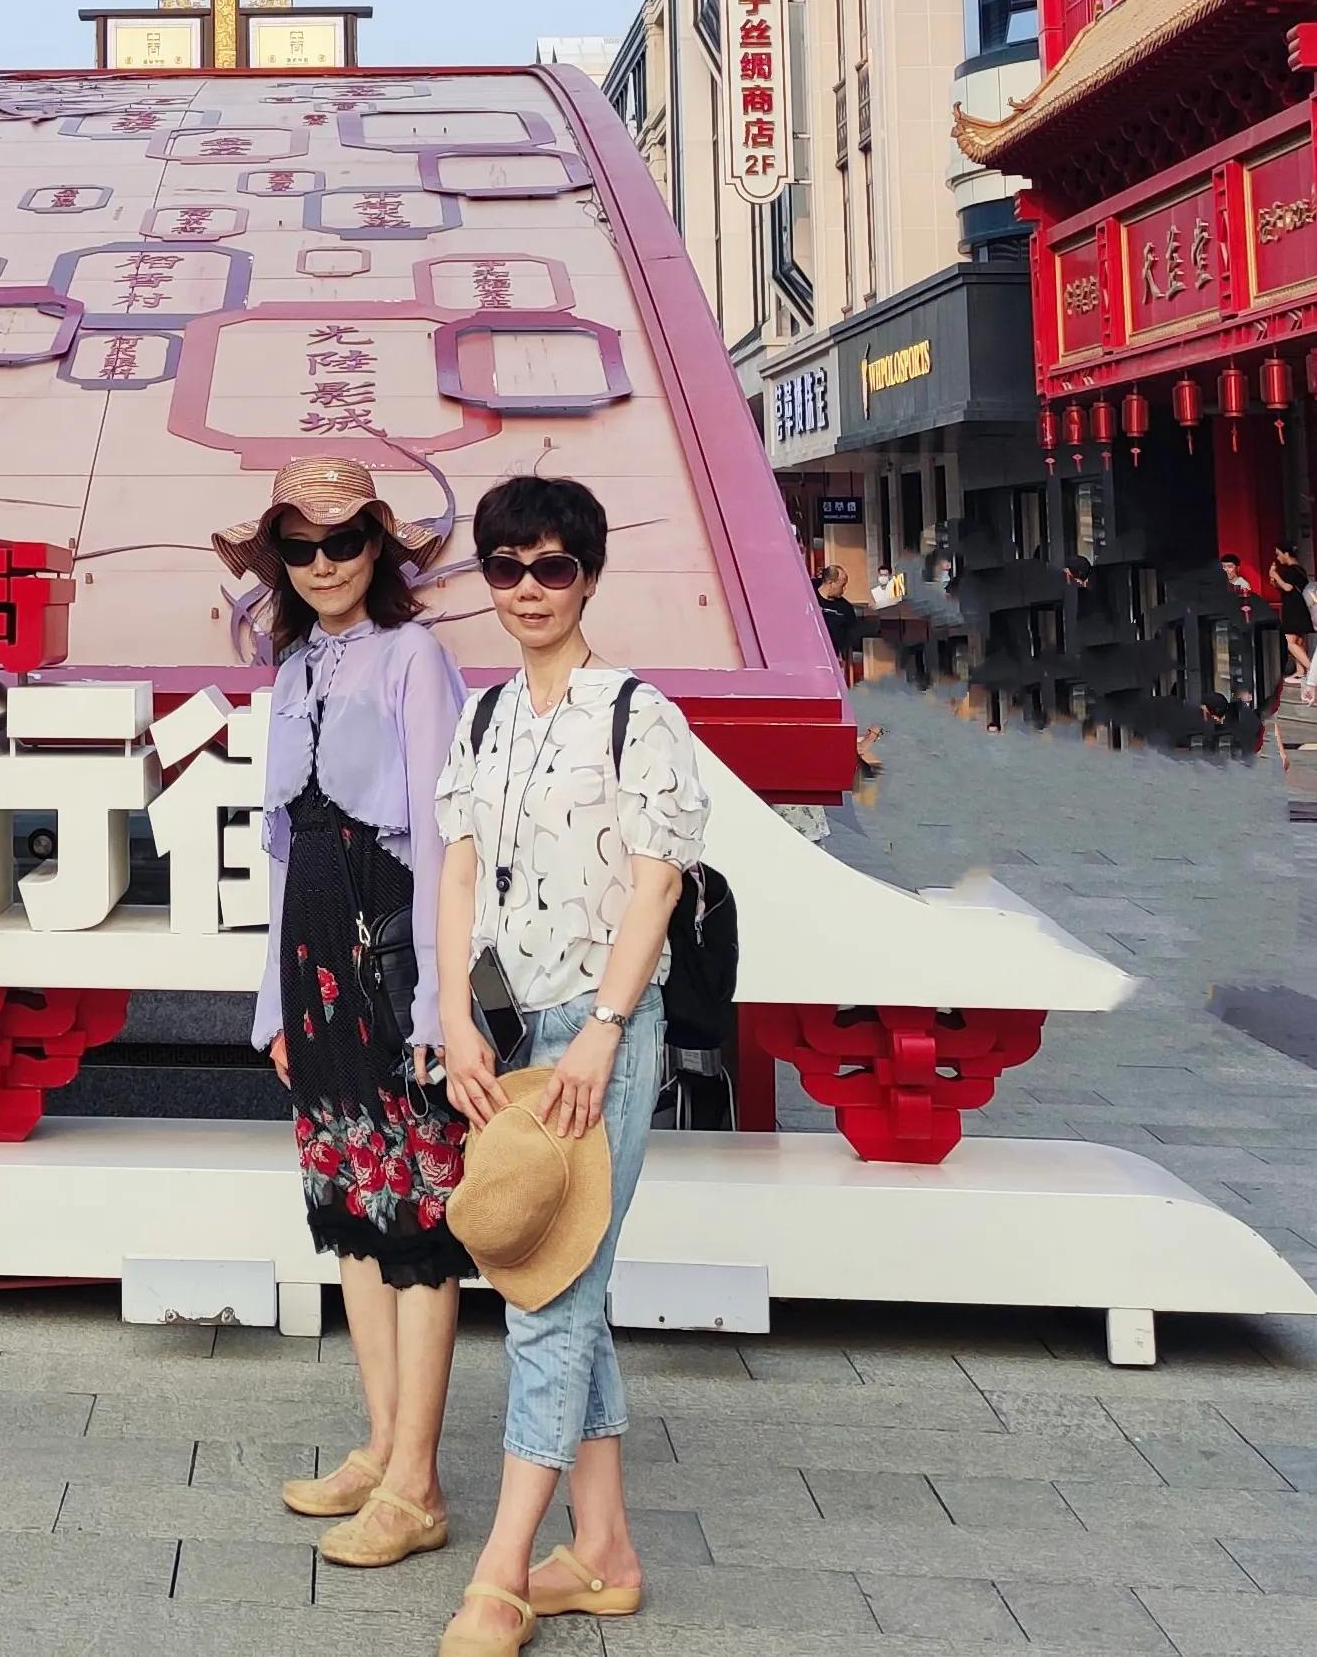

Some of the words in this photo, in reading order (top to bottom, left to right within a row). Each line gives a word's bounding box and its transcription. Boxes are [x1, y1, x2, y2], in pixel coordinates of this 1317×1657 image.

[744, 154, 776, 176] 2F
[112, 254, 184, 308] 稻香村
[98, 334, 144, 380] 何氏眼科
[299, 324, 388, 438] 光陸影城
